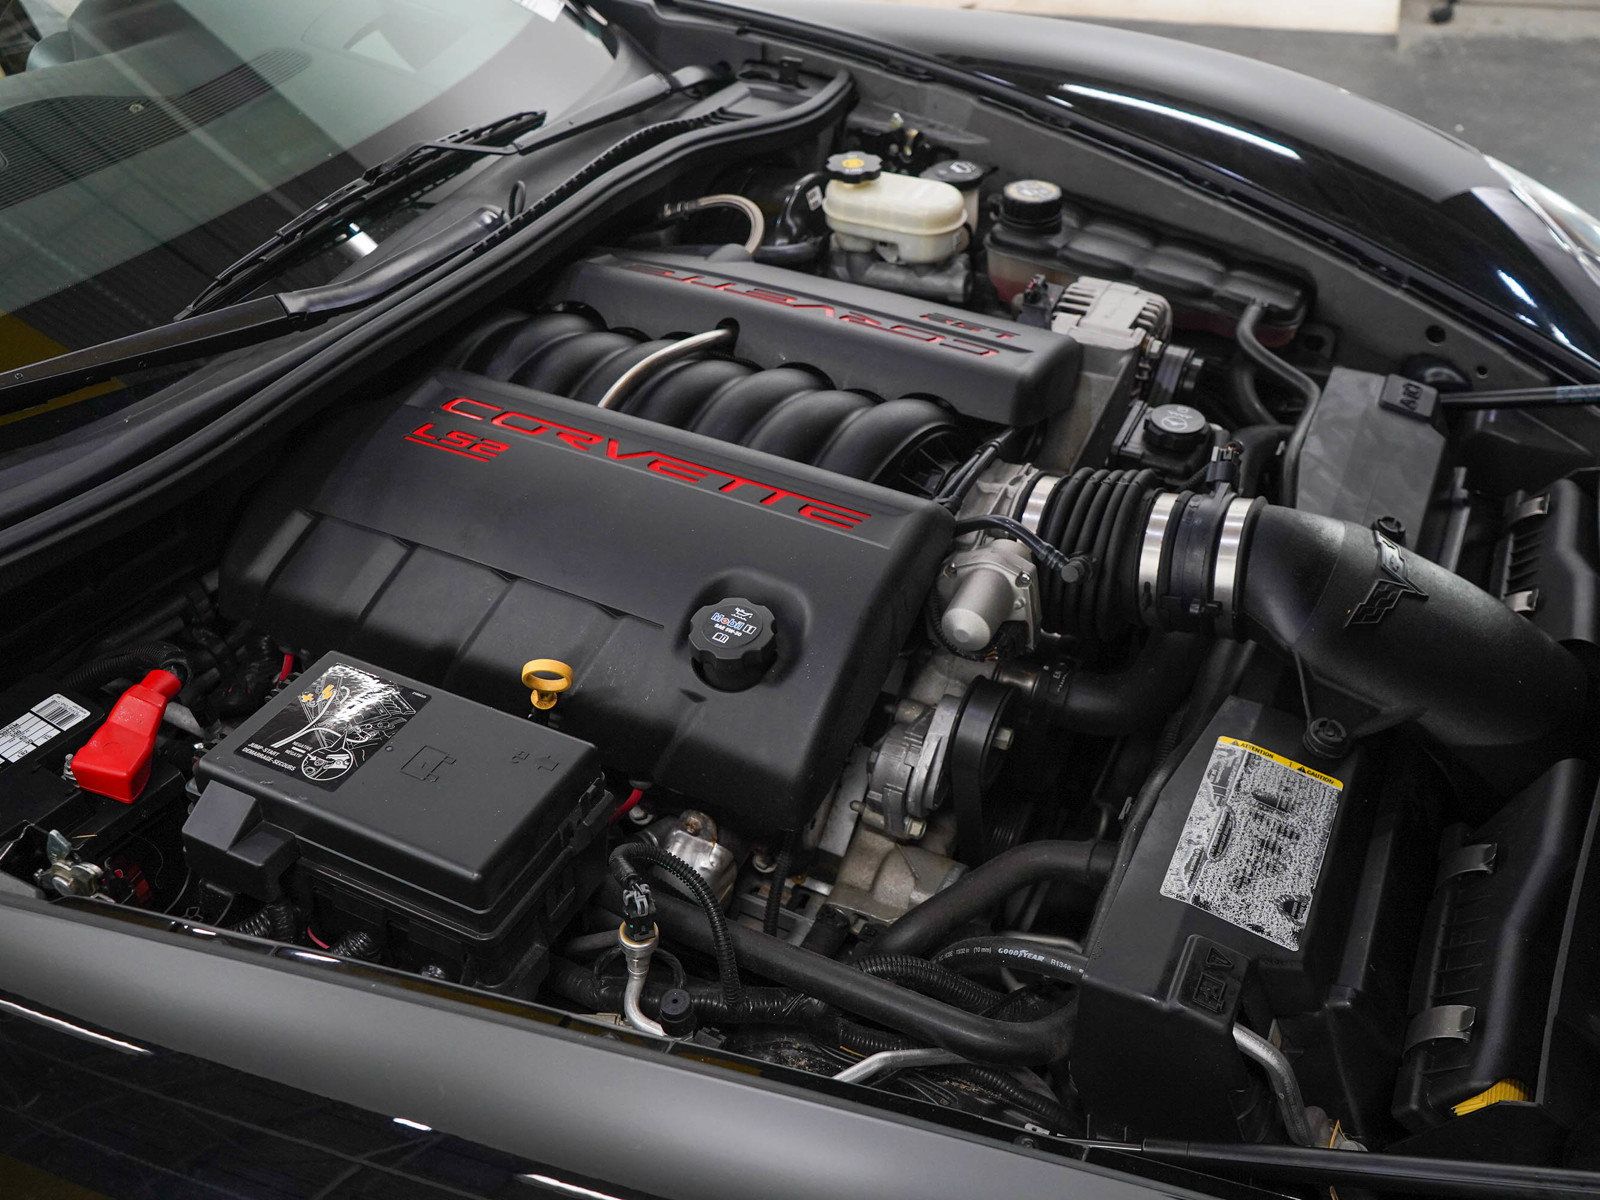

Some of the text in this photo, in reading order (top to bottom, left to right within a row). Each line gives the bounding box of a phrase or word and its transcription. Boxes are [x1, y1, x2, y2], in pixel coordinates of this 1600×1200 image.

[624, 265, 999, 356] CORVETTE
[409, 423, 511, 459] LS2
[441, 397, 871, 529] CORVETTE
[711, 612, 744, 630] Mobil
[248, 742, 280, 756] JUMP-START
[1240, 743, 1334, 784] ATTENTION CAUTION
[998, 948, 1045, 962] GOODYEAR
